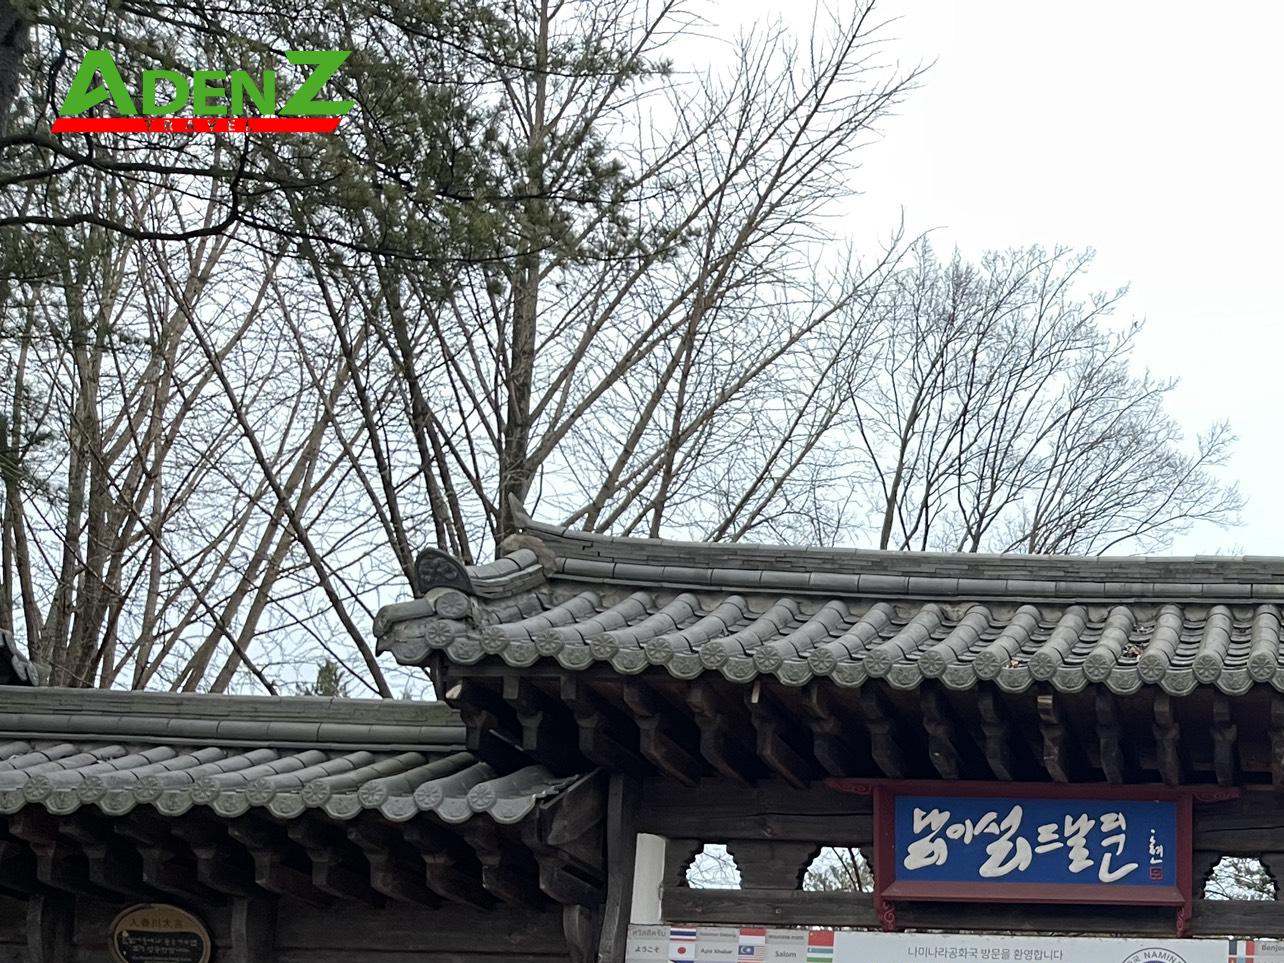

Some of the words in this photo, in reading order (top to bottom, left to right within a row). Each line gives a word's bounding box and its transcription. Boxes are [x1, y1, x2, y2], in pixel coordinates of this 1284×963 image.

[907, 946, 978, 959] 나미나라공화국
[980, 948, 1011, 960] 방문을
[1013, 949, 1064, 961] 환영합니다
